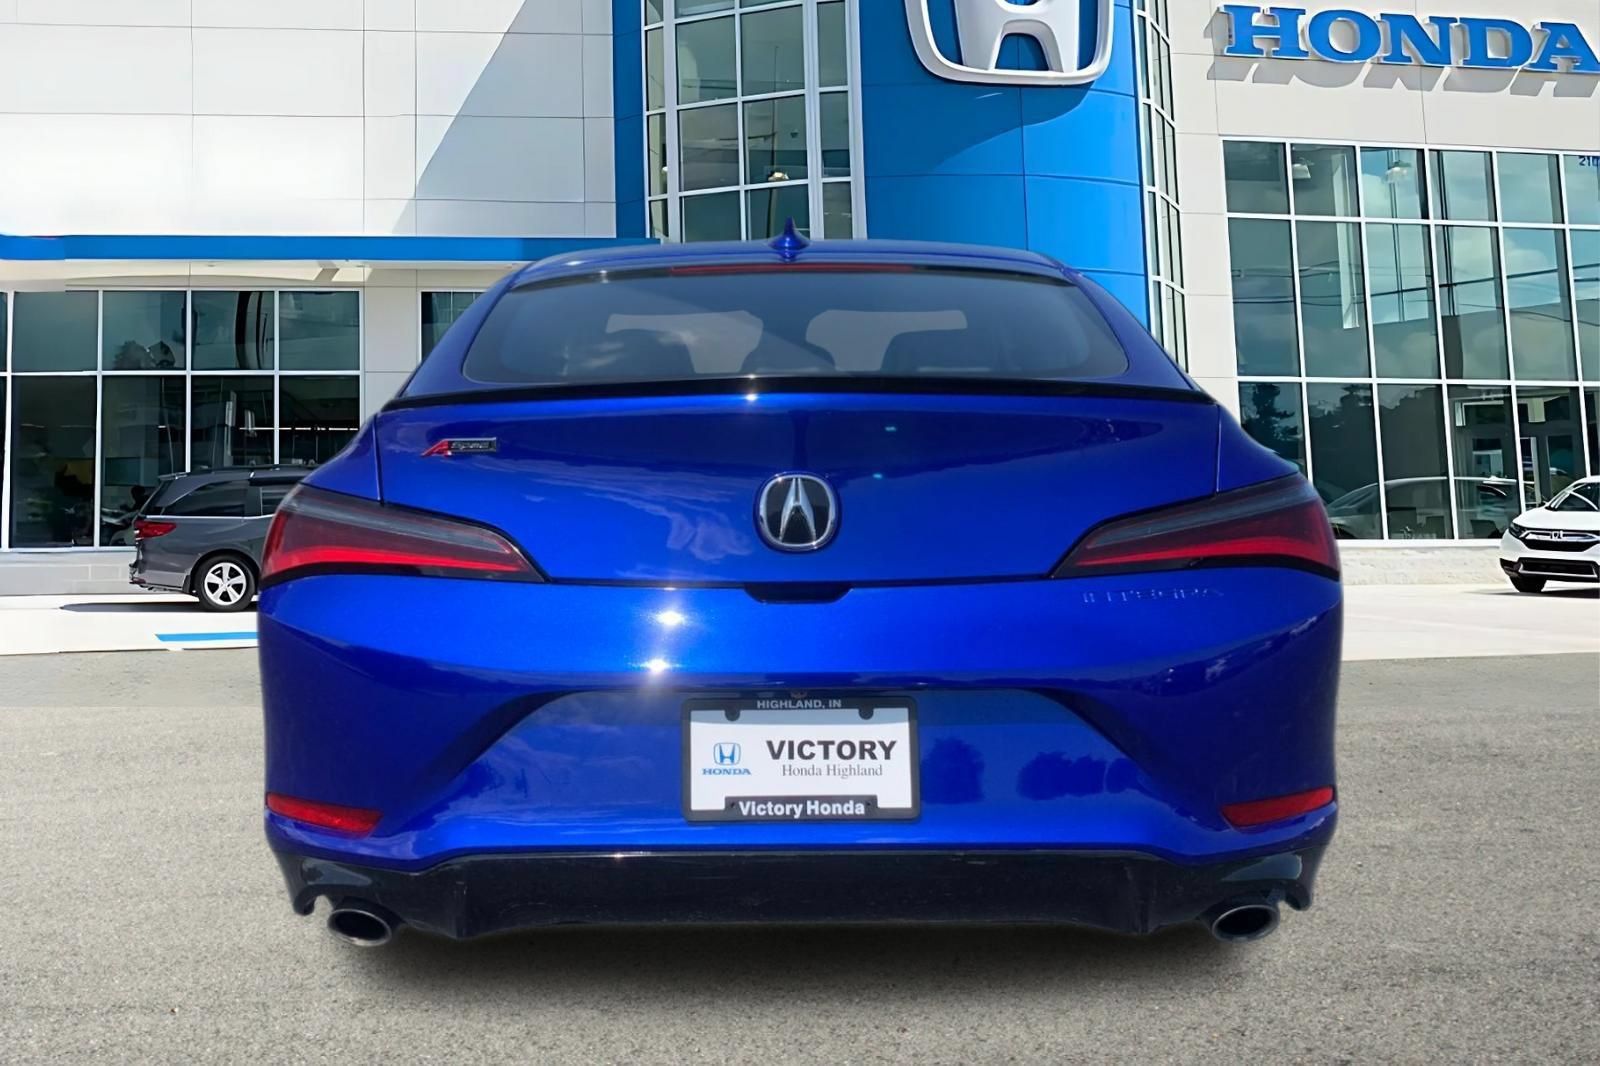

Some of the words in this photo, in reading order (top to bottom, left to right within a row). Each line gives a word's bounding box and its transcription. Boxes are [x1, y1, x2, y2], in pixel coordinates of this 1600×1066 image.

[1222, 4, 1600, 72] HONDA
[756, 699, 826, 709] HIGHLAND,
[828, 699, 842, 708] IN
[766, 740, 897, 760] VICTORY
[702, 768, 751, 776] HONDA
[781, 764, 823, 777] Honda
[826, 764, 883, 779] Highland
[738, 801, 803, 819] Victory
[806, 800, 865, 816] Honda
